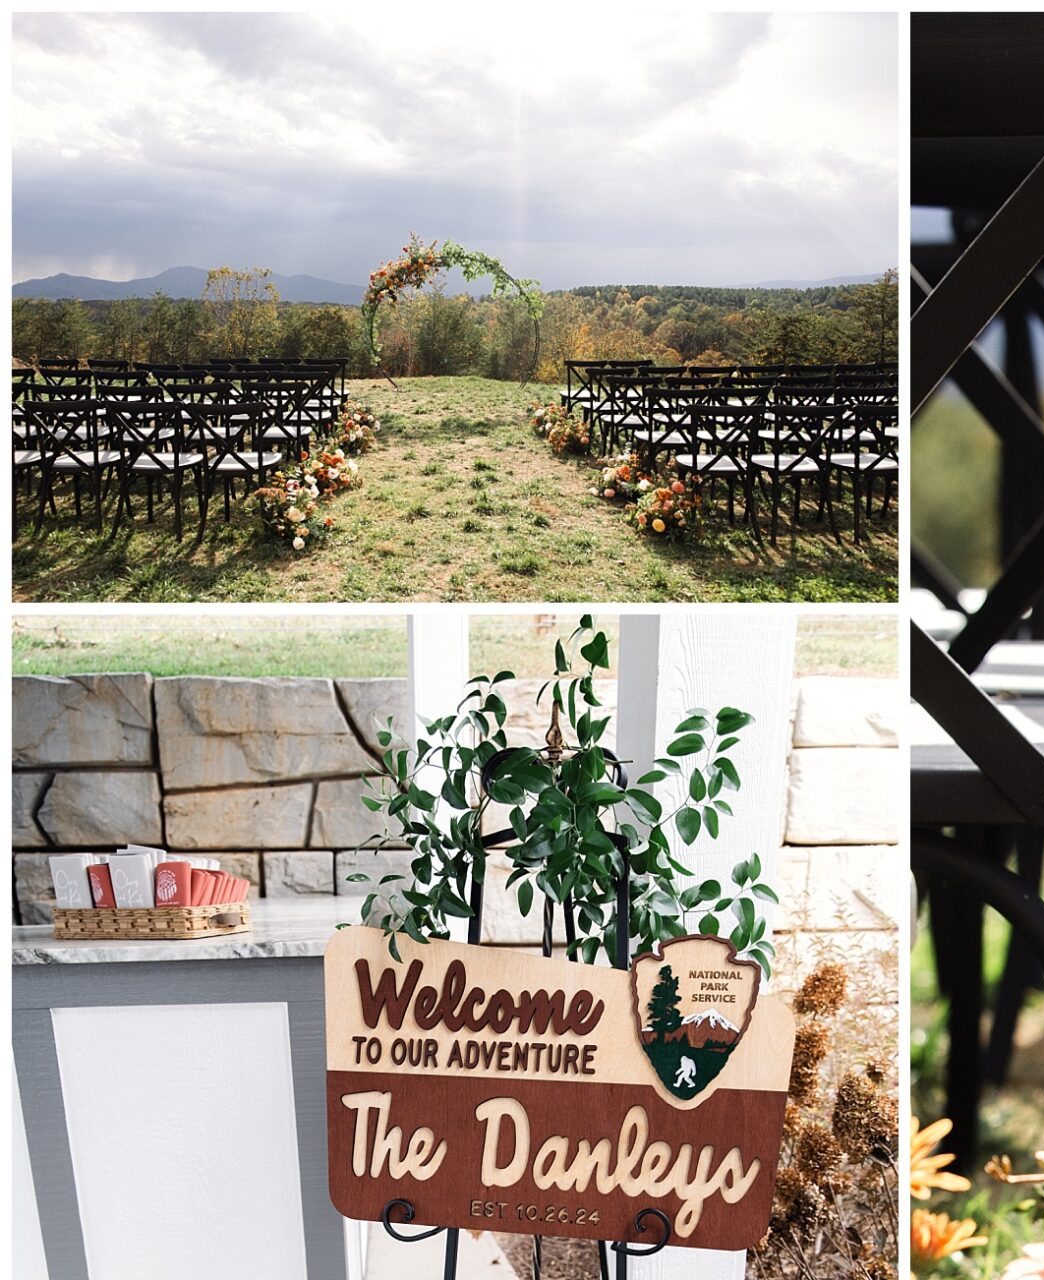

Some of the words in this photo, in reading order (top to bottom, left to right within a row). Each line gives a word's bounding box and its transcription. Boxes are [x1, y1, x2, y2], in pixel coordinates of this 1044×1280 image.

[688, 969, 743, 981] NATIONAL
[700, 982, 729, 992] PARK
[354, 957, 605, 1036] Welcome
[691, 993, 736, 1003] SERVICE
[352, 1036, 383, 1065] TO
[390, 1038, 438, 1068] OUR
[447, 1040, 598, 1076] ADVENTURE
[341, 1090, 447, 1182] The
[475, 1097, 762, 1239] Danleys
[470, 1199, 509, 1218] EST
[515, 1204, 601, 1227] 10.26.24
